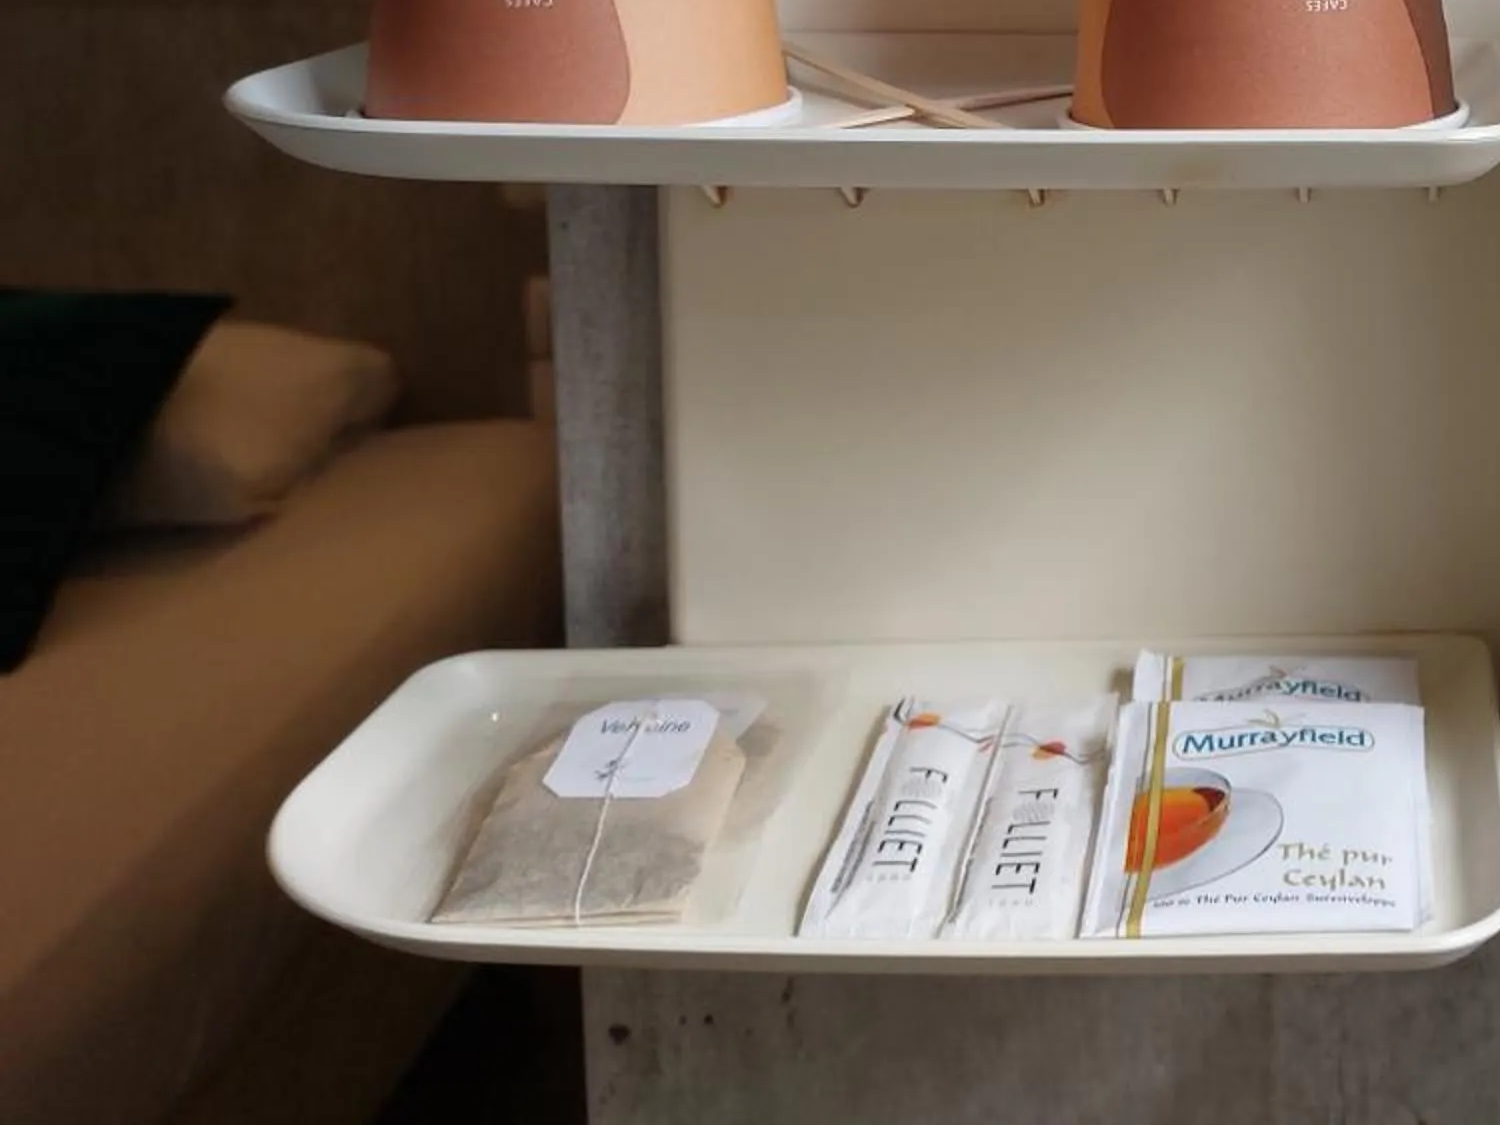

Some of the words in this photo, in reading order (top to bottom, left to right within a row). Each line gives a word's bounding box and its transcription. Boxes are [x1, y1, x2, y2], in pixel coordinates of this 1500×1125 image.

[1182, 727, 1365, 755] Murrayfield
[1277, 842, 1331, 861] Thé
[1343, 848, 1394, 867] pur
[1283, 868, 1386, 890] Ceylan
